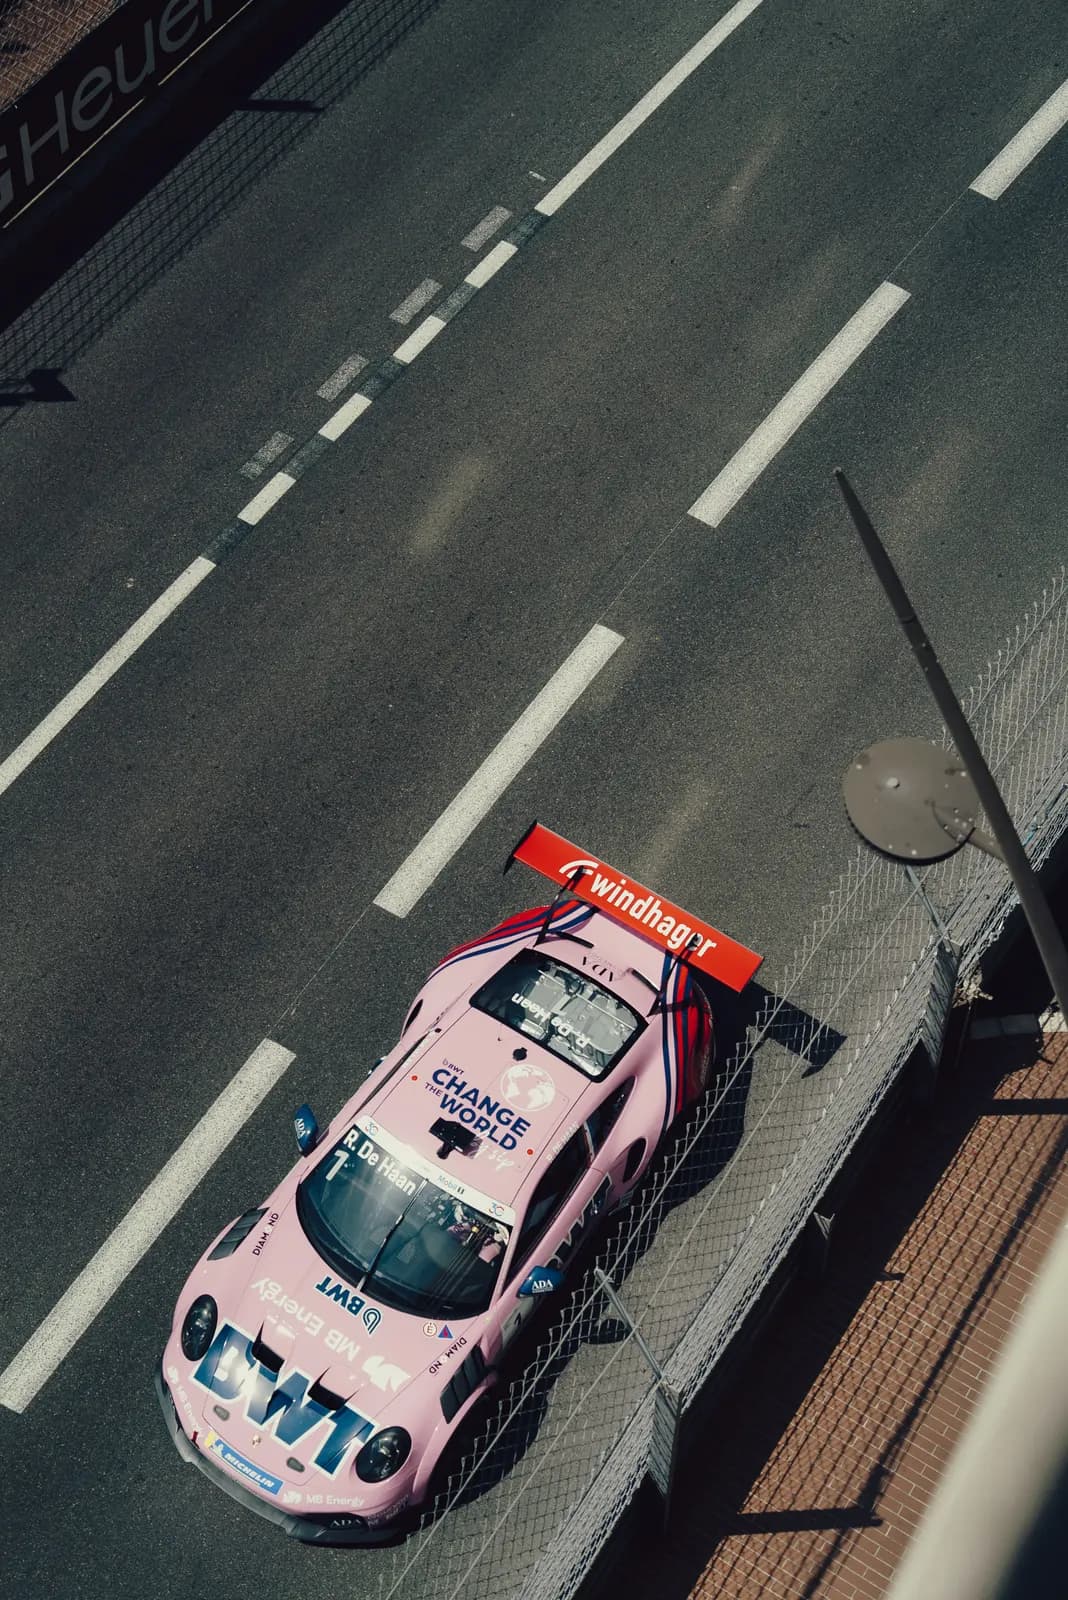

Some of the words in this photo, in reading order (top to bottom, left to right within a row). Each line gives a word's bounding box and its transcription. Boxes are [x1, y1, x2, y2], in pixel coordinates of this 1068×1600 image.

[589, 872, 717, 958] windhager
[511, 992, 555, 1024] Haan
[551, 1017, 572, 1036] De
[424, 1082, 442, 1097] THE
[432, 1068, 531, 1138] CHANGE
[439, 1093, 517, 1151] WORLD
[326, 1150, 349, 1181] 1
[344, 1130, 356, 1151] R.
[356, 1140, 377, 1166] De
[377, 1156, 416, 1195] Haan
[314, 1275, 365, 1316] BWT
[532, 1279, 554, 1290] ADA
[251, 1277, 326, 1336] Energy
[324, 1328, 363, 1361] MB
[192, 1318, 376, 1480] BWT
[223, 1450, 276, 1489] MICHELIN
[305, 1494, 324, 1505] MB
[325, 1494, 365, 1508] Energy
